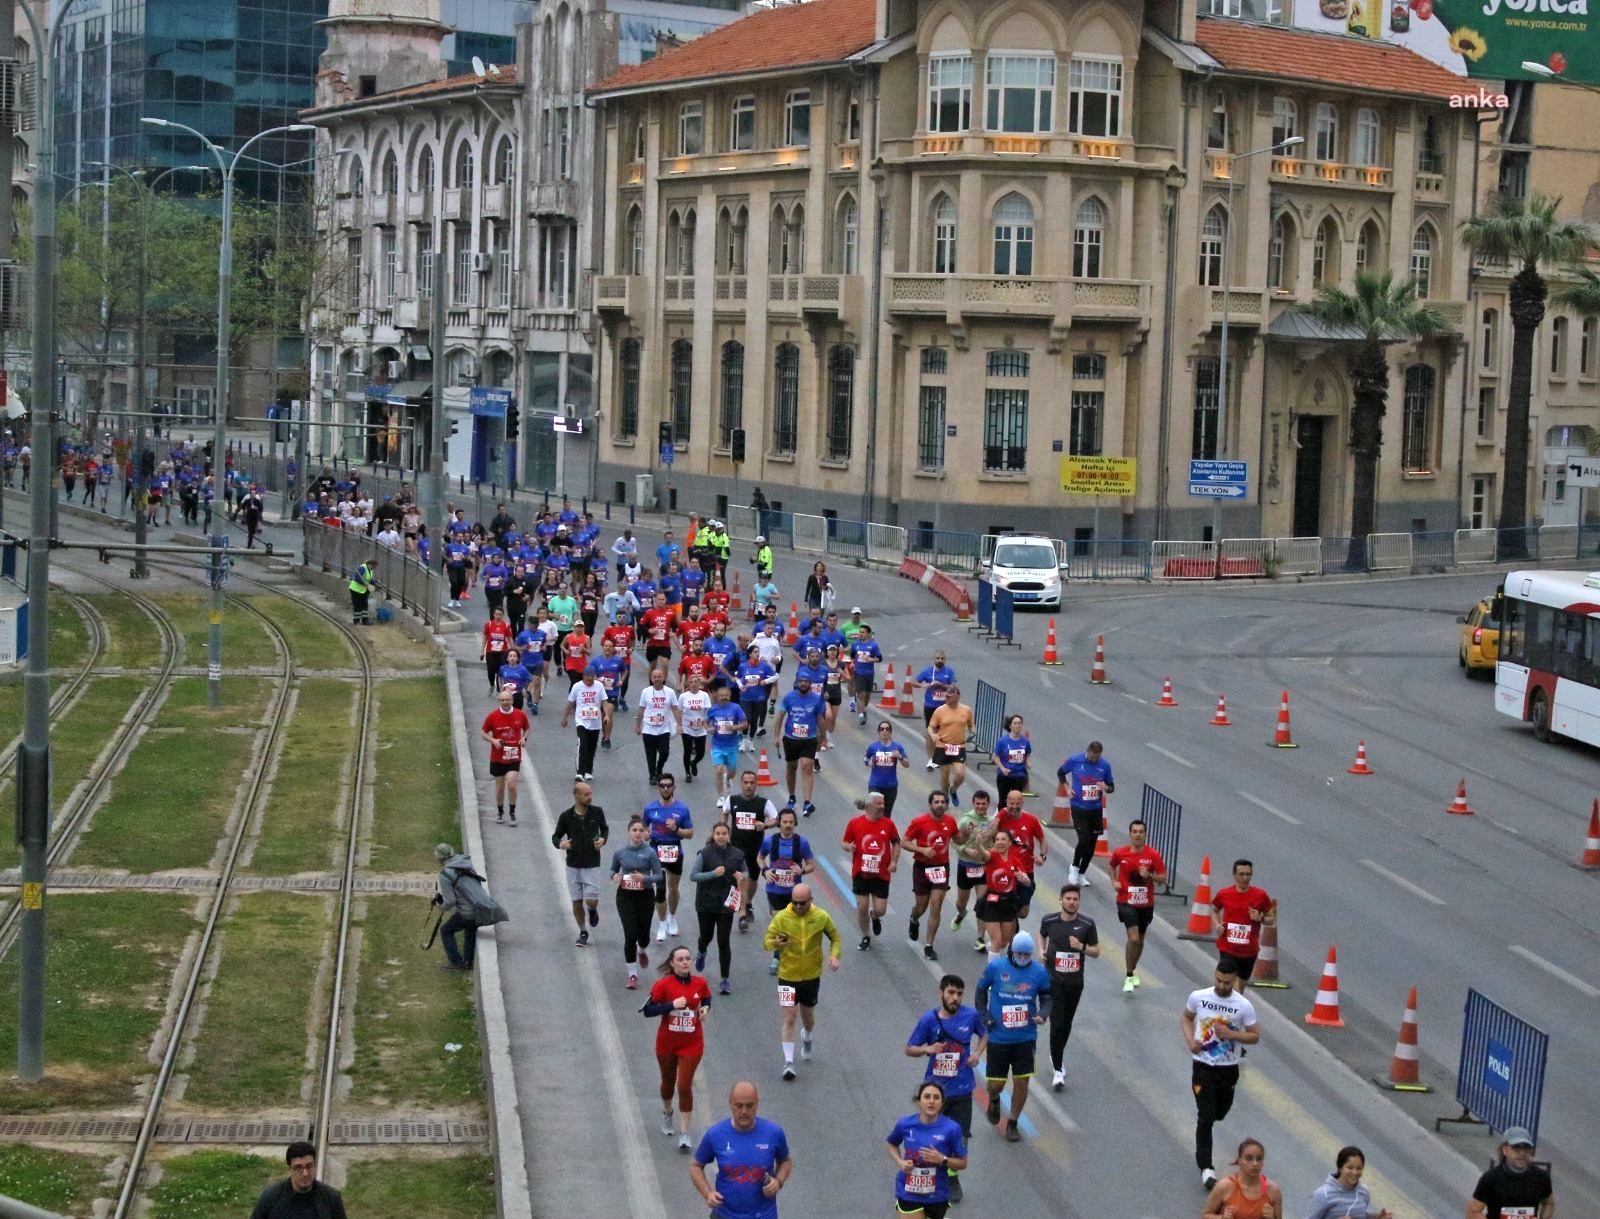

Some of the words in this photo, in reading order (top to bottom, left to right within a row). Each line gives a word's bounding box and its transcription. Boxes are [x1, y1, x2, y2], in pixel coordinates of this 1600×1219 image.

[1505, 18, 1587, 31] www.yonca.com.tr
[1069, 456, 1105, 464] Alsancak
[1107, 457, 1128, 465] Yönü
[1583, 467, 1600, 476] Als
[1211, 486, 1229, 494] YÖN
[1229, 929, 1248, 939] 3777
[1058, 959, 1077, 968] 4073
[1201, 1000, 1239, 1014] Vosmer
[672, 1017, 693, 1027] 4165
[1006, 1012, 1026, 1022] 3910
[936, 1060, 957, 1070] 3205
[1488, 1054, 1510, 1081] POLİS
[909, 1175, 933, 1186] 3035
